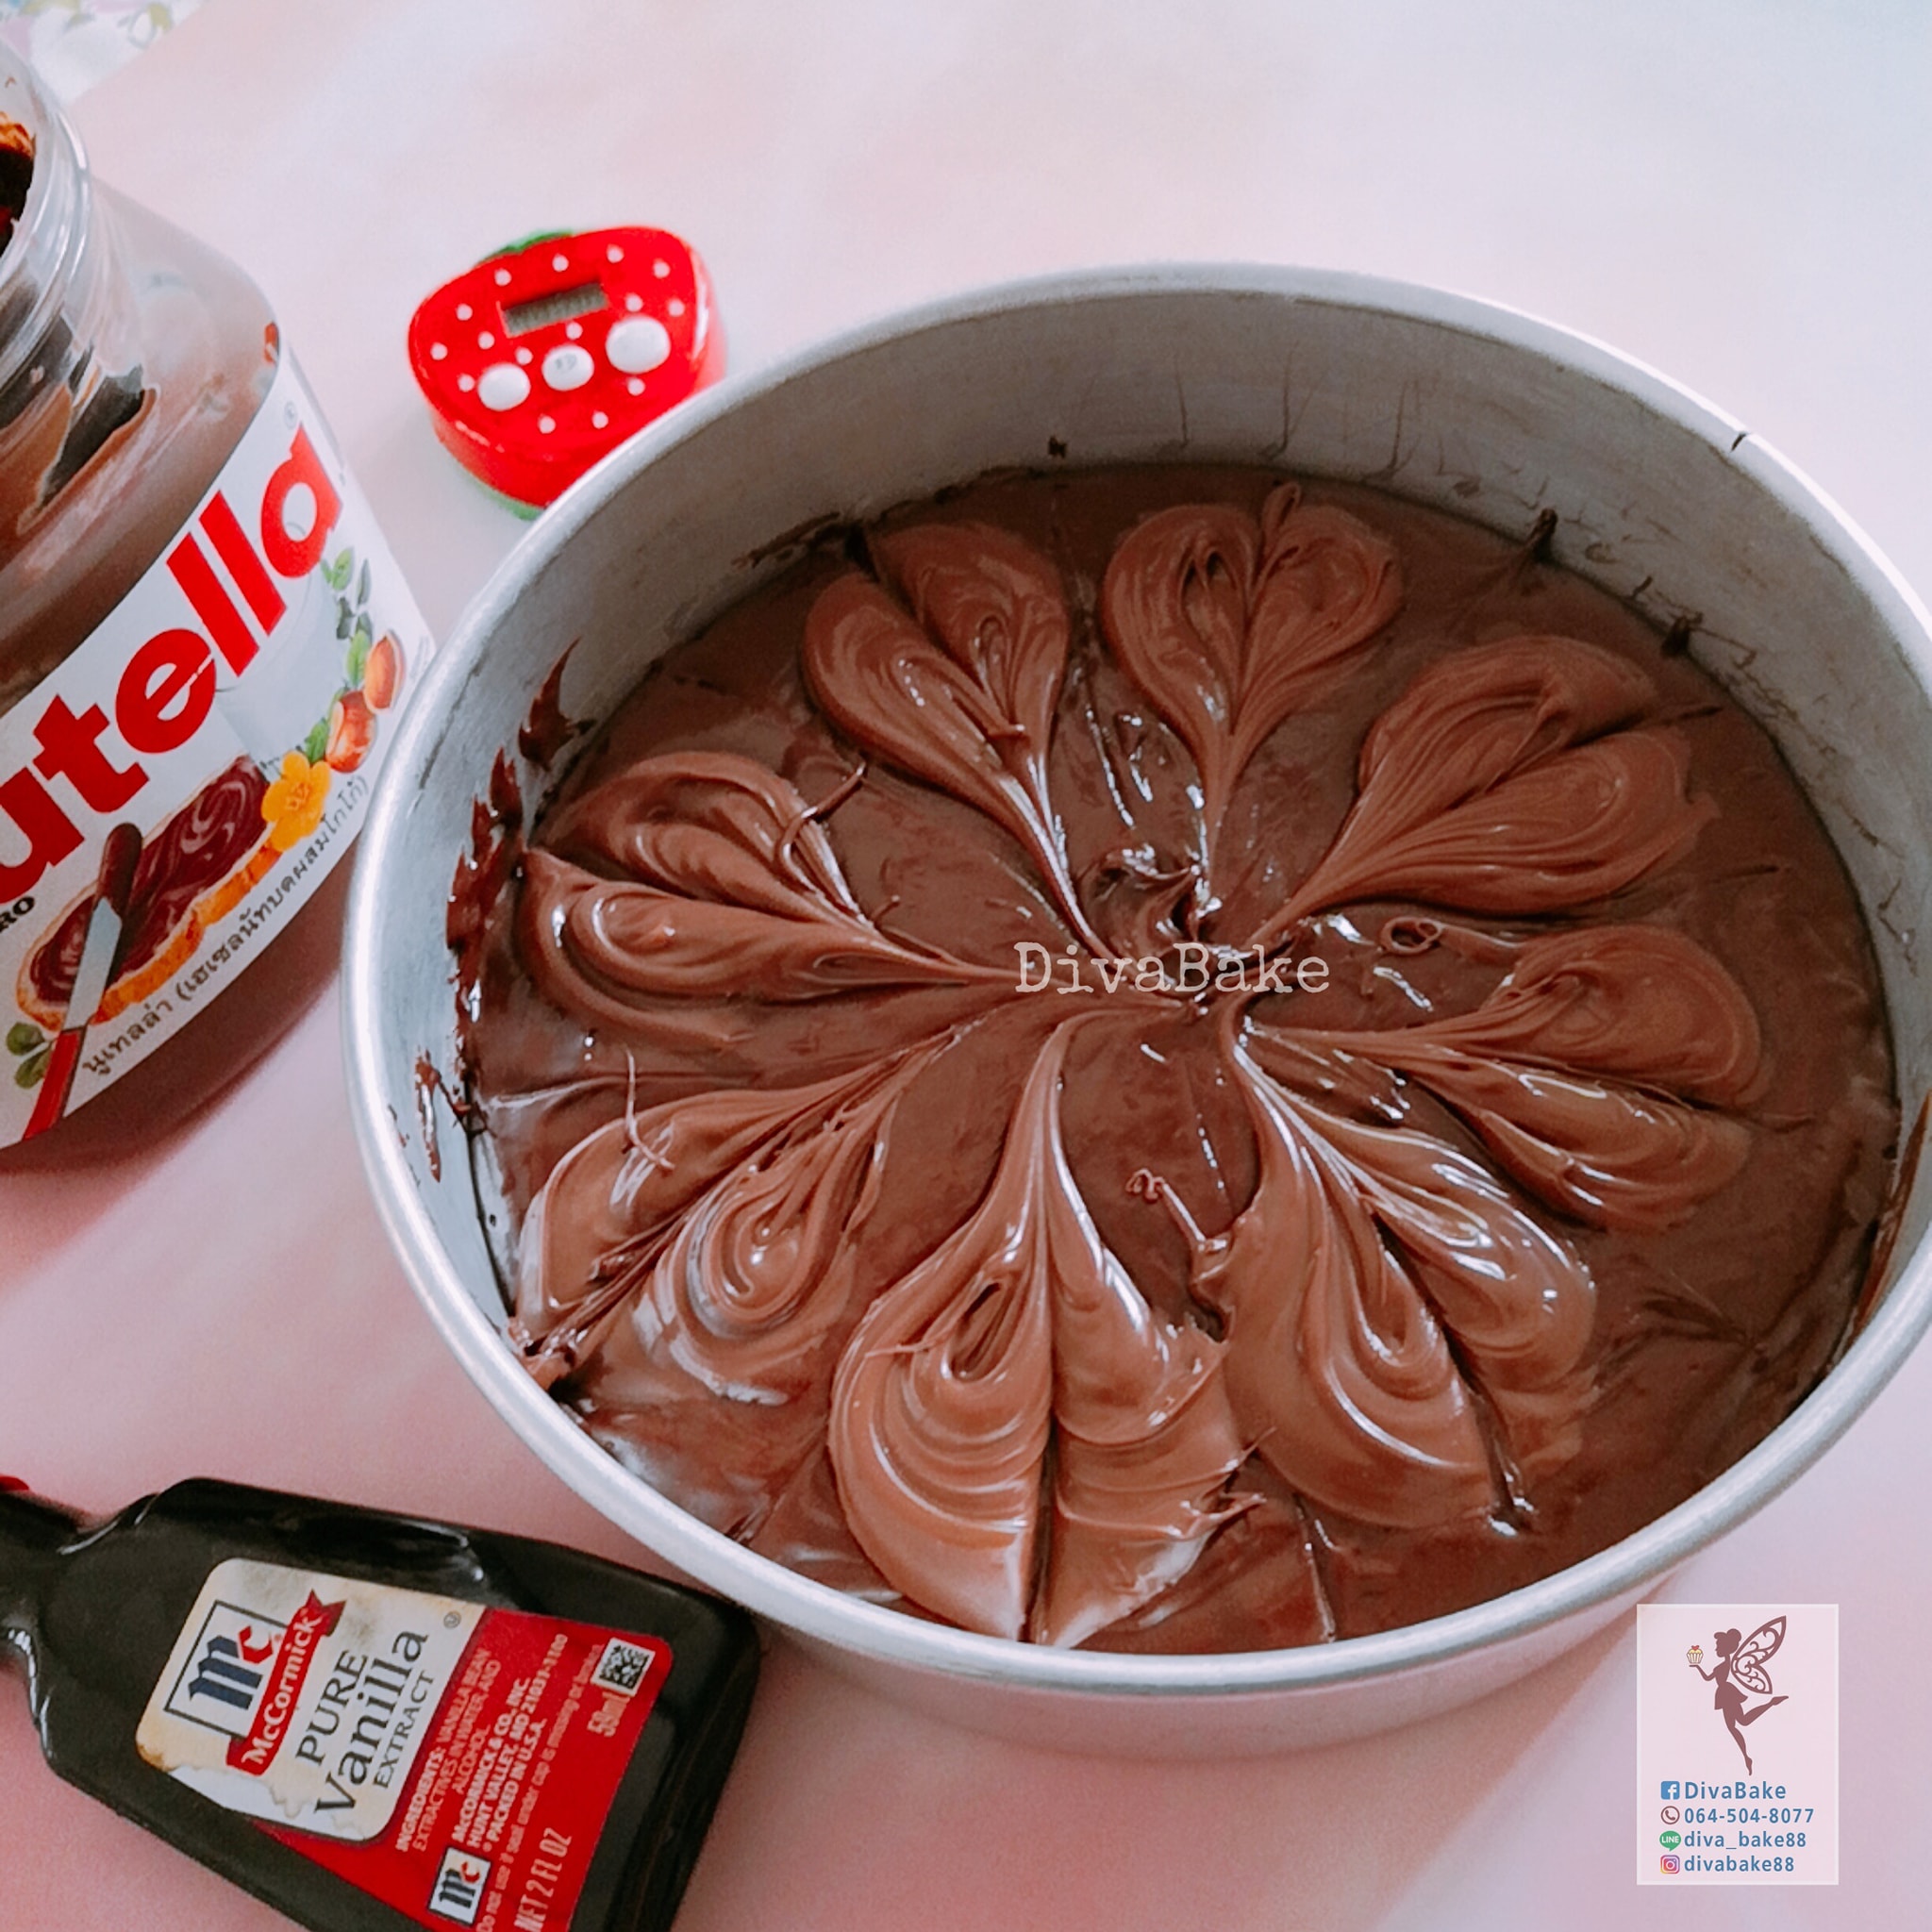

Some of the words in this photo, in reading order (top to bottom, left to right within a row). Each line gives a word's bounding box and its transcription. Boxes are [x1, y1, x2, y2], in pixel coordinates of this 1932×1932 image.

[82, 1000, 174, 1076] นูเทลล่า
[296, 1651, 367, 1764] PURE
[315, 1632, 427, 1811] Vanilla
[374, 1674, 432, 1788] EXTRACT
[413, 1759, 457, 1851] EXTRACTIVES
[450, 1740, 465, 1757] IN
[478, 1660, 500, 1691] AND
[395, 1747, 445, 1852] INGREDIENTS:
[437, 1688, 471, 1741] VANILLA
[467, 1802, 492, 1847] HUNT
[509, 1713, 529, 1740] MD
[486, 1780, 519, 1841] PACKED
[509, 1761, 526, 1780] IN
[526, 1880, 553, 1897] 2
[531, 1859, 561, 1881] FL
[540, 1828, 571, 1857] OZ
[514, 1894, 547, 1932] NET
